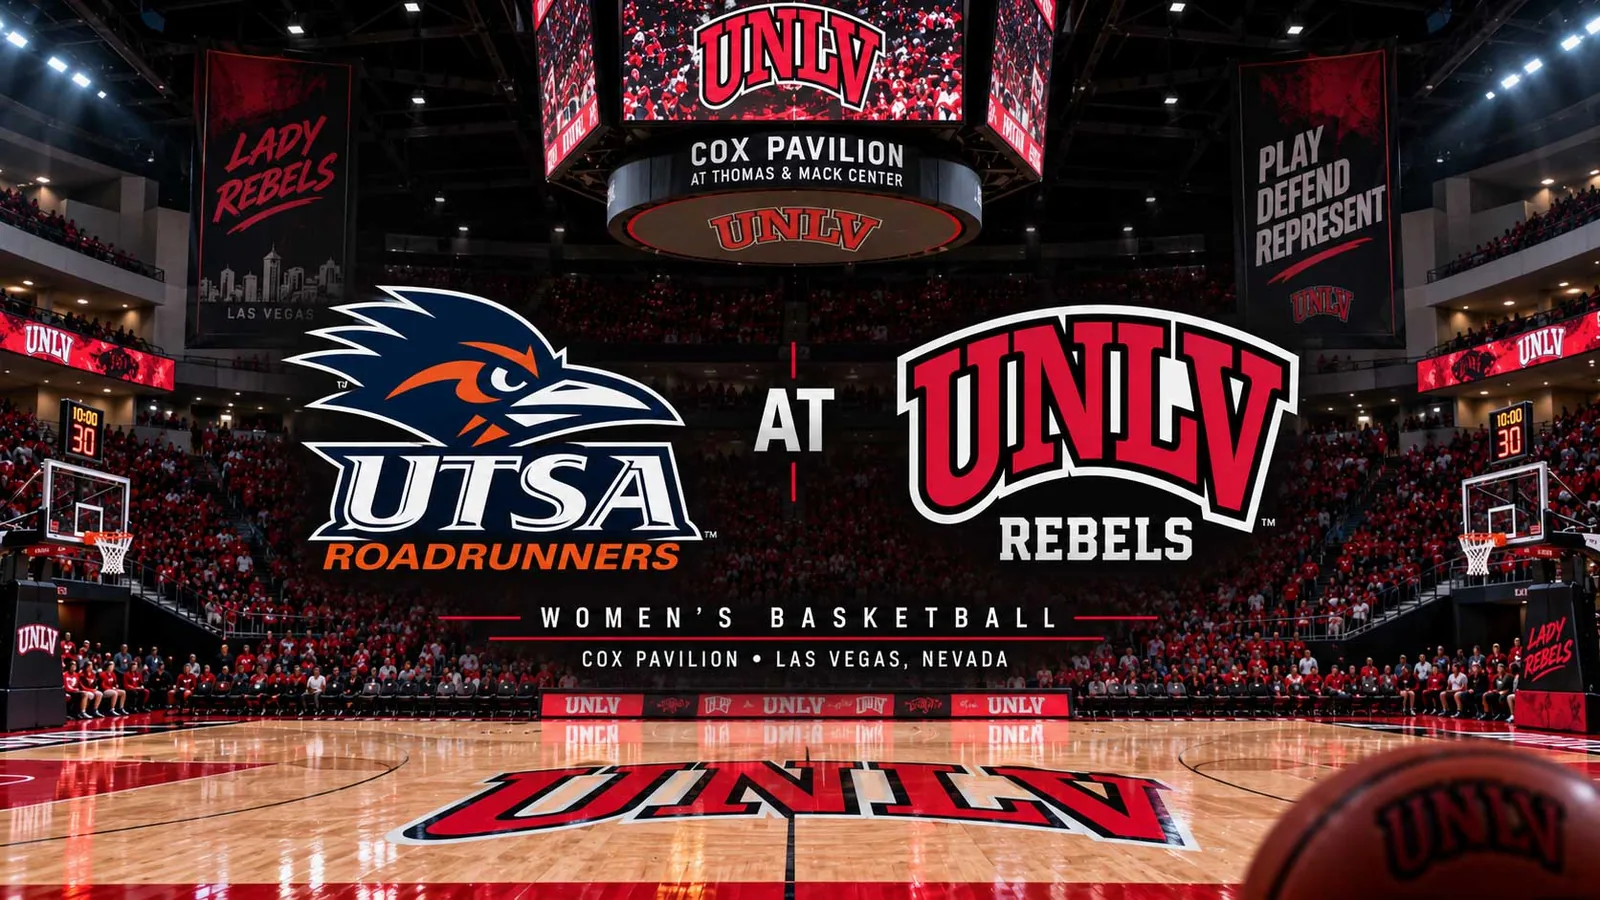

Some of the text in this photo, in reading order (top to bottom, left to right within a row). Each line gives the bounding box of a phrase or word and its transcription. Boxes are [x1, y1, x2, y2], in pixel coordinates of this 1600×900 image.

[693, 2, 886, 111] UNLV
[225, 115, 327, 173] LADY
[690, 135, 904, 168] COX PAVILION
[1259, 125, 1324, 183] PLAY
[212, 152, 338, 223] REBELS
[691, 166, 903, 187] AT THOMAS & MACK CENTER
[1257, 157, 1350, 225] DEFEND
[708, 206, 883, 252] UNLV
[1255, 184, 1386, 267] REPRESENT
[227, 307, 314, 321] LAS VEGAS
[1290, 285, 1354, 323] UNLV
[25, 324, 74, 365] UNLV
[1516, 326, 1566, 368] UNLV
[73, 406, 98, 427] 10:00
[1497, 407, 1522, 427] 10:00
[72, 424, 95, 456] 30
[1498, 426, 1521, 458] 30
[16, 623, 60, 657] UNLV
[1527, 616, 1567, 649] LADY
[1523, 639, 1574, 679] REBELS
[565, 696, 621, 714] UNLV
[763, 696, 825, 714] UNLV
[987, 697, 1046, 714] UNLV
[386, 760, 1202, 850] UNLV
[1376, 778, 1567, 880] UNLV
